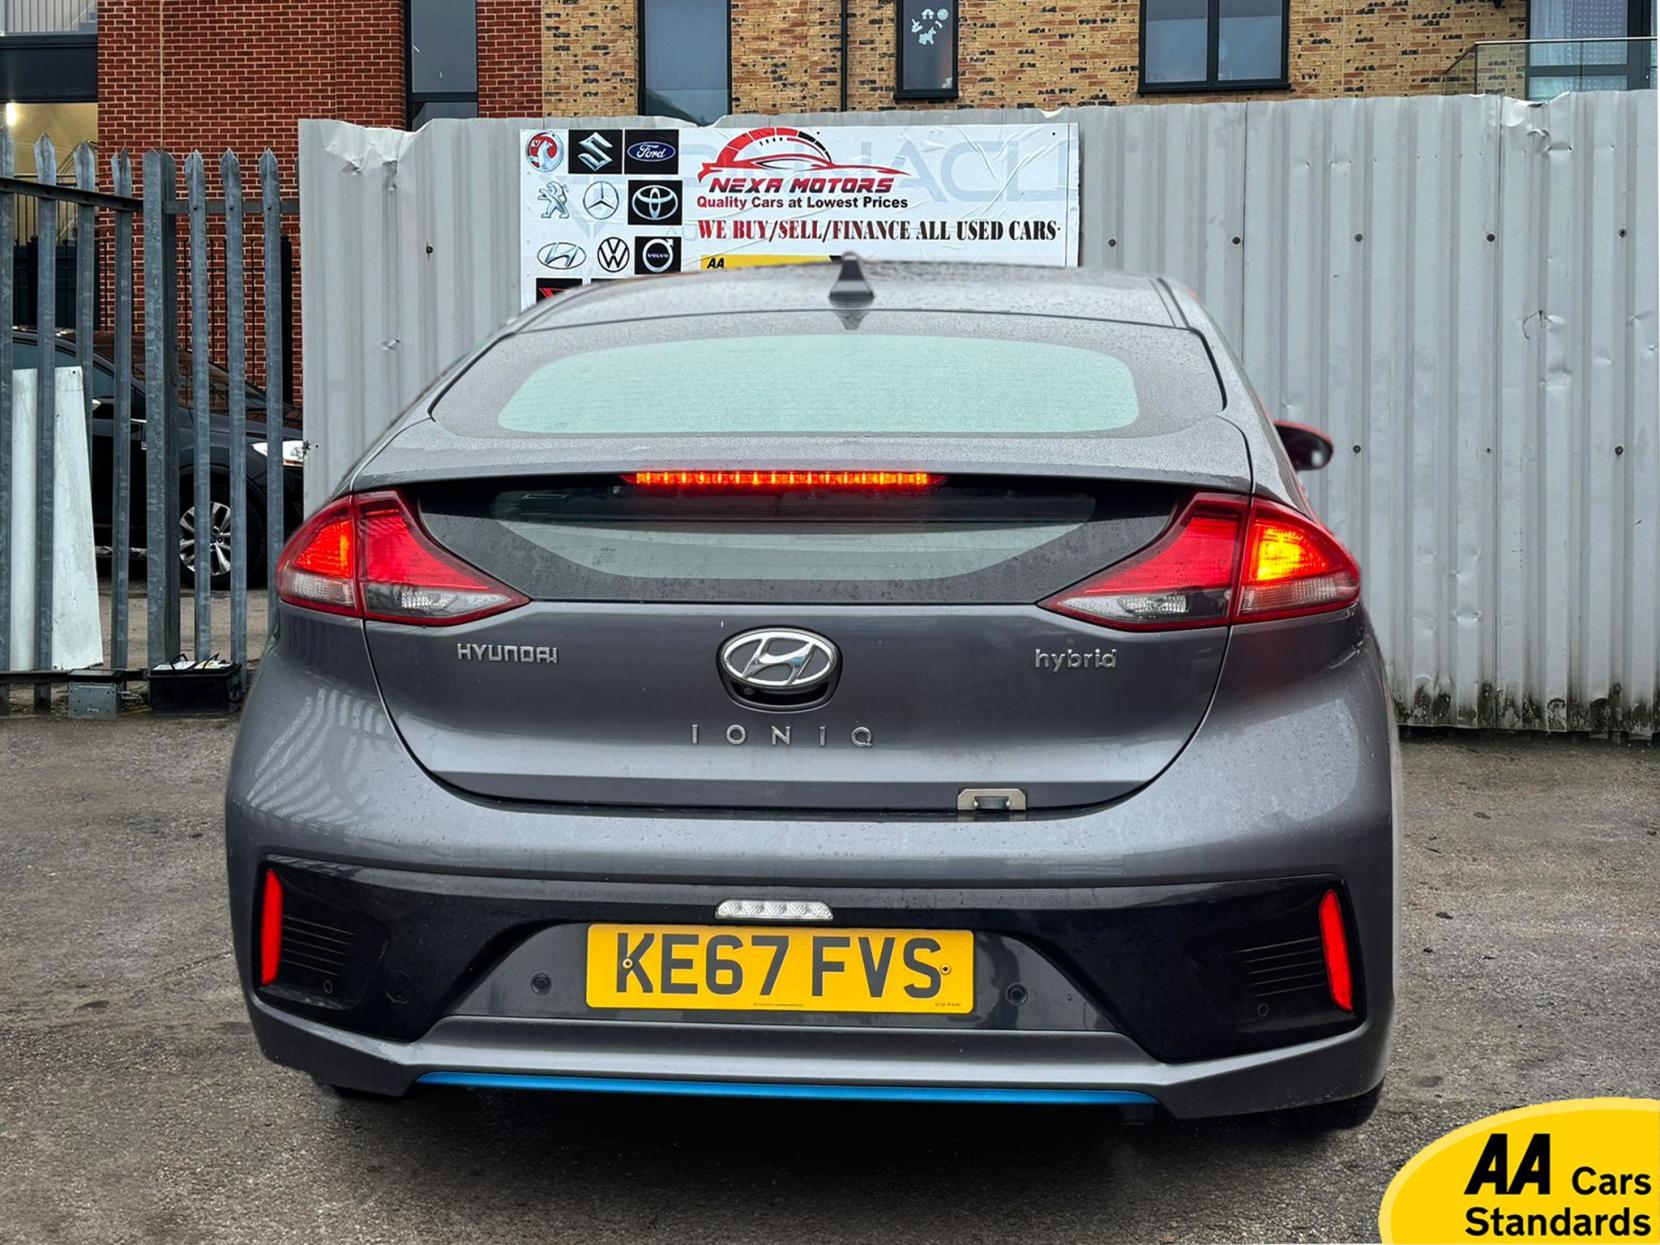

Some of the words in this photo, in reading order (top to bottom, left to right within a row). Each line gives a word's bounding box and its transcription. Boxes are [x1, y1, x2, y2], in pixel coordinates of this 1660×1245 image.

[636, 144, 667, 159] Ford
[708, 177, 784, 194] NEXA
[789, 177, 895, 194] MOTORS
[696, 195, 747, 210] Quality
[752, 196, 784, 208] Cars
[788, 196, 803, 208] at
[807, 195, 859, 208] Lowest
[863, 195, 908, 208] Prices
[697, 219, 727, 239] WE
[733, 219, 911, 242] BUY/SELL/FINANCE
[916, 220, 951, 240] ALL
[956, 220, 1003, 240] USED
[1008, 220, 1057, 240] CARS
[707, 257, 725, 269] AA
[457, 643, 558, 664] HYUNDAI
[1035, 648, 1117, 672] hybrid
[691, 723, 874, 748] IONIQ
[615, 932, 790, 997] KE67
[811, 935, 943, 999] FVS
